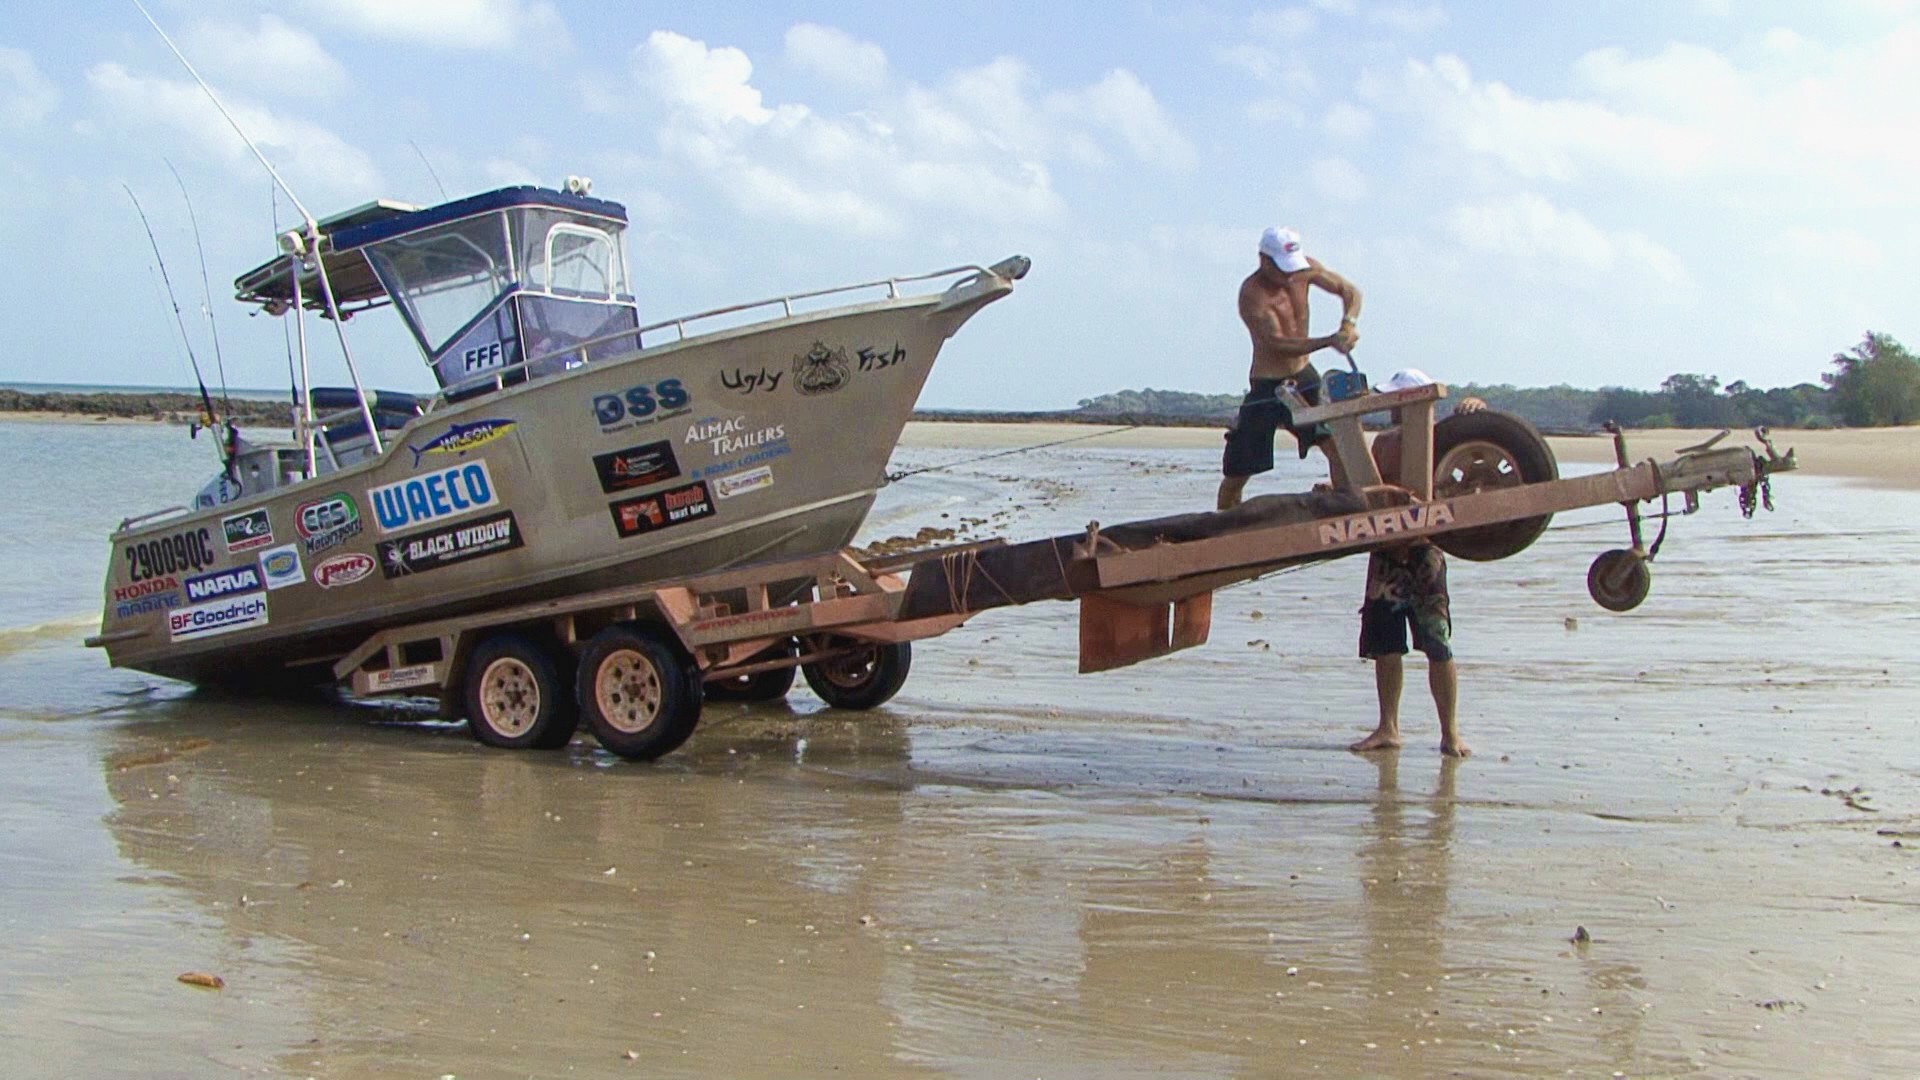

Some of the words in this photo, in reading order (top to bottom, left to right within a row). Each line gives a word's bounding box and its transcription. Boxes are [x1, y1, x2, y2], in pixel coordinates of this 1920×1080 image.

[465, 343, 499, 371] FFF
[721, 367, 783, 394] Ugly
[857, 340, 906, 371] Fish
[440, 424, 494, 452] WILSON
[684, 415, 745, 444] ALMAC
[709, 423, 785, 456] TRAILERS
[373, 464, 491, 530] WAECO
[409, 533, 454, 560] BLACK
[456, 518, 511, 548] WIDOW
[1319, 503, 1455, 545] NARVA
[126, 528, 214, 582] 29009QC
[114, 577, 178, 601] HONDA
[188, 569, 258, 598] NARVA
[171, 600, 266, 630] BFGoodrich
